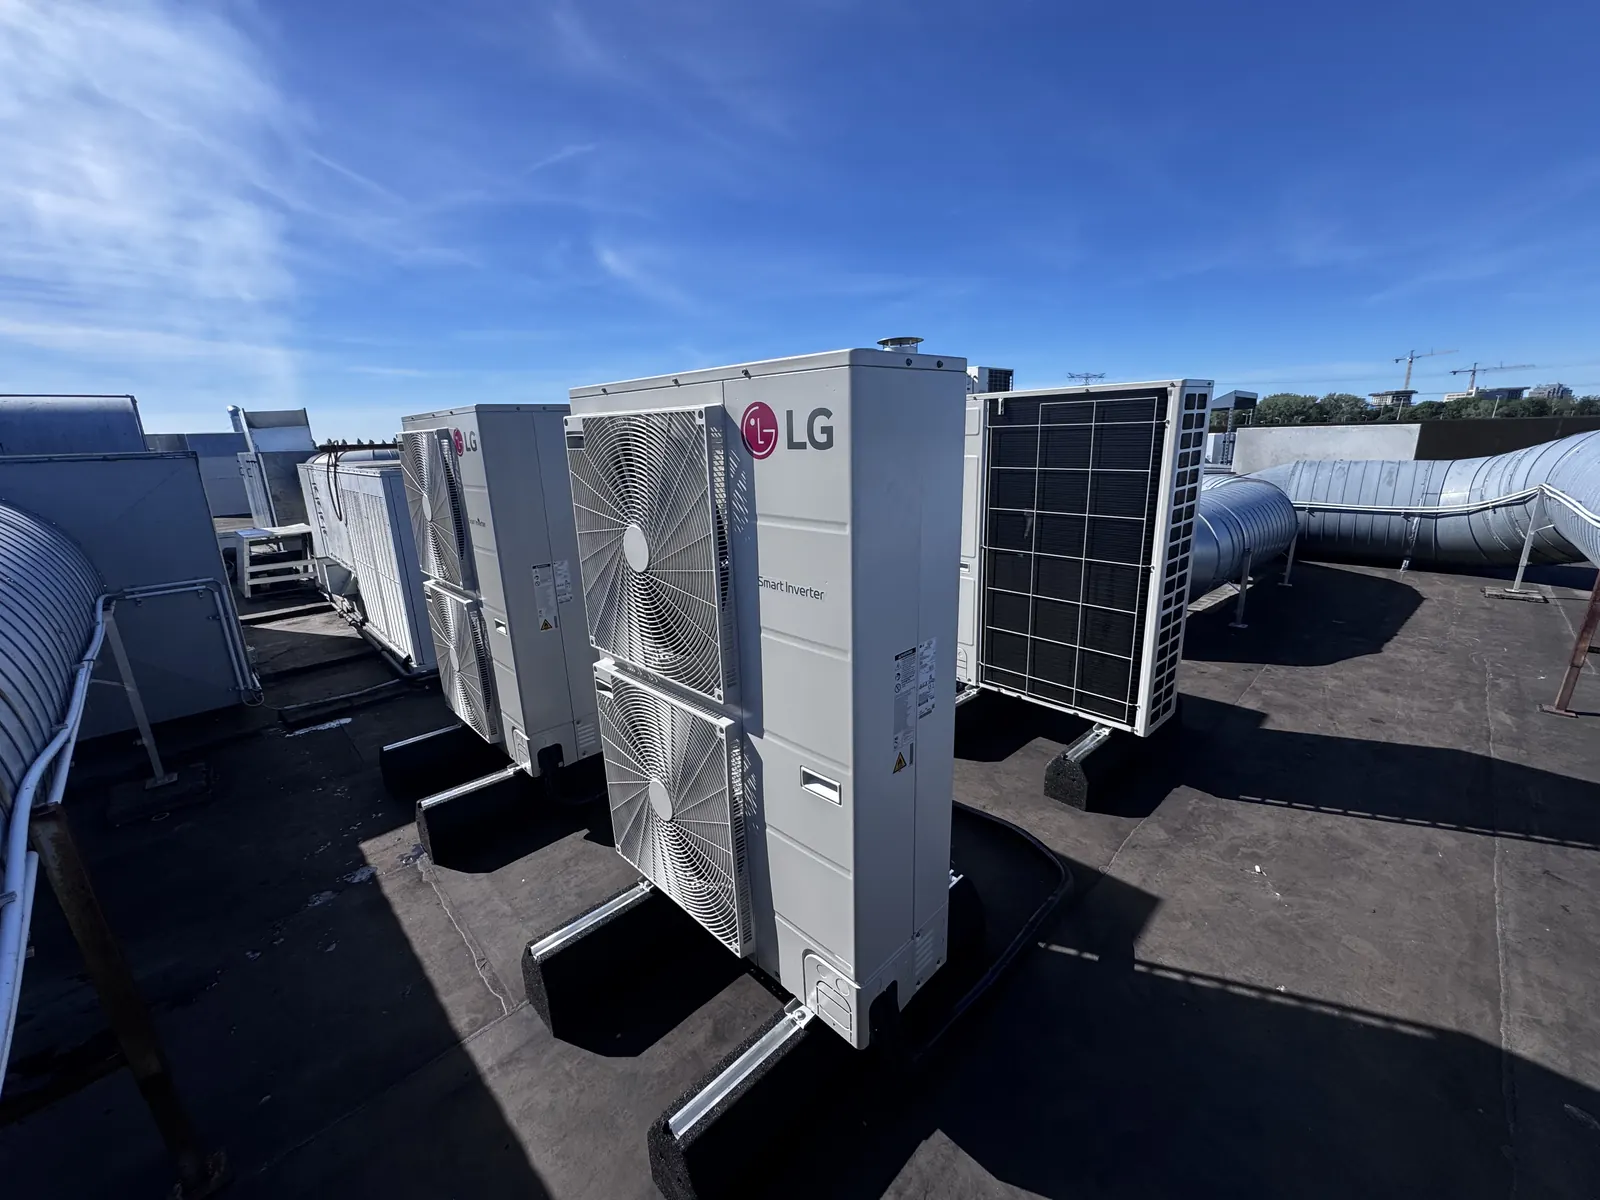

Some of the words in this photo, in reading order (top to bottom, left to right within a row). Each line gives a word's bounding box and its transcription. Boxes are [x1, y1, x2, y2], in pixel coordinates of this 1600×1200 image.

[464, 431, 478, 452] LG
[786, 407, 834, 451] LG
[757, 575, 784, 592] Smart
[785, 581, 825, 601] Inverter
